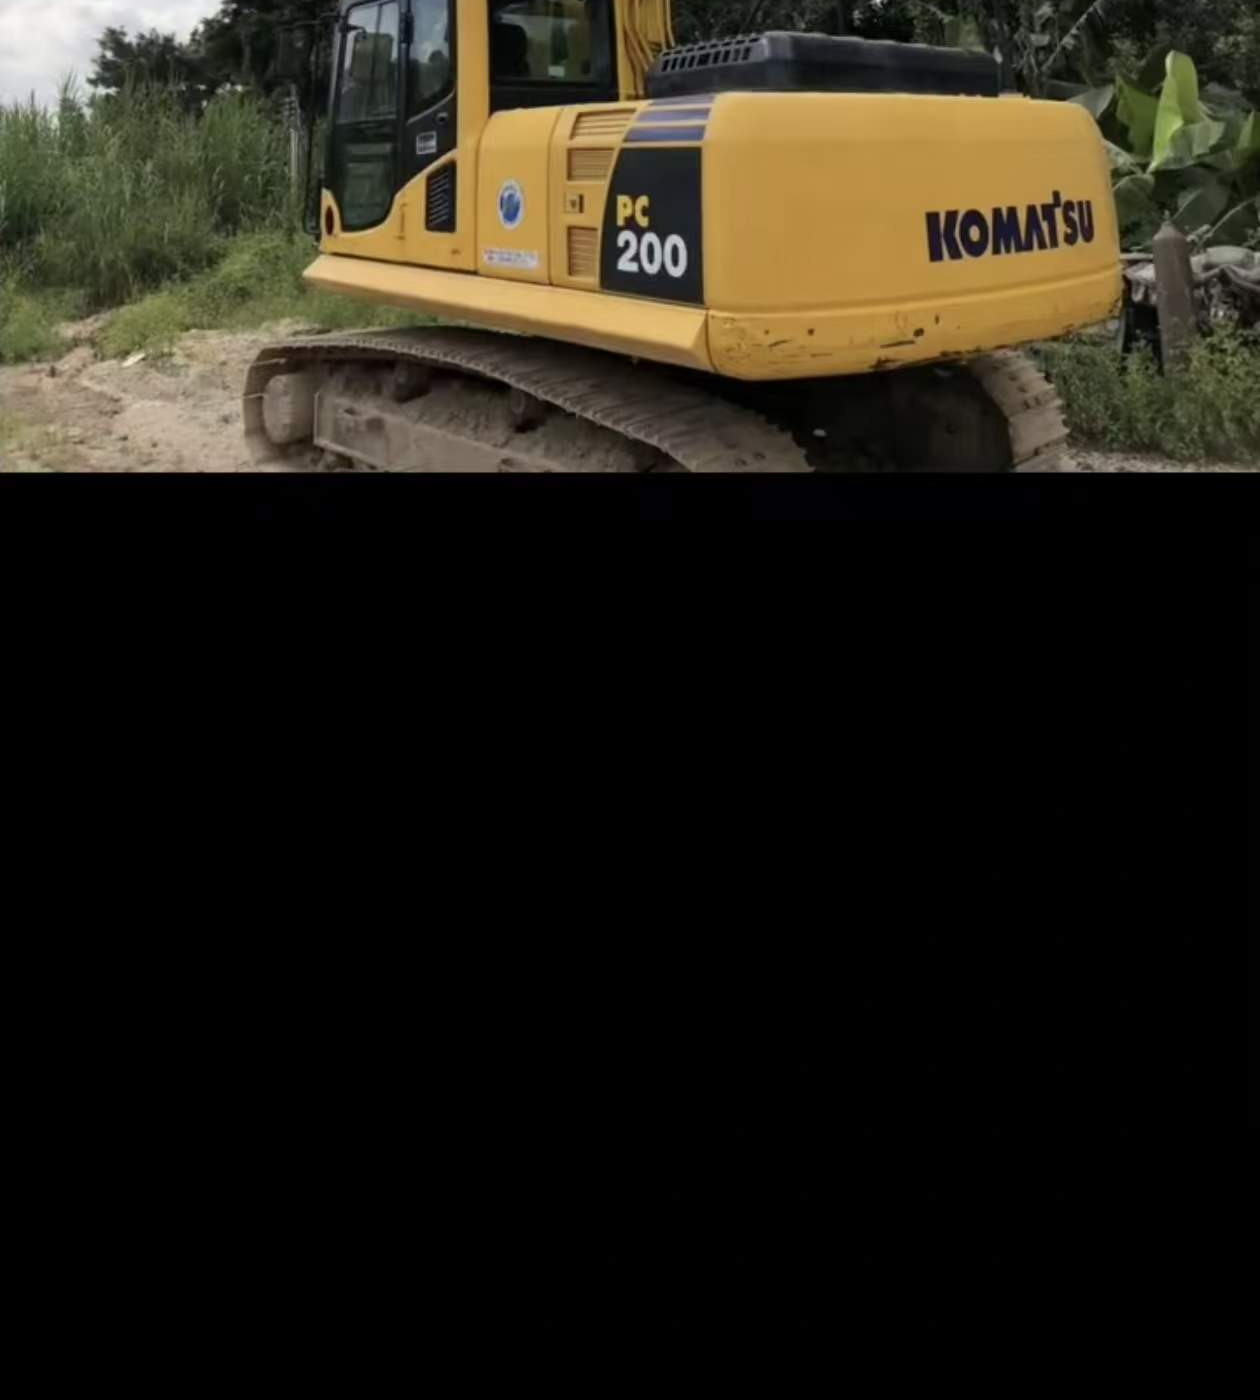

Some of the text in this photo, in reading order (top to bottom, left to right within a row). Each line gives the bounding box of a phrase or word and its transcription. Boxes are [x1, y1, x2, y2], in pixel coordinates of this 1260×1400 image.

[617, 195, 649, 227] PC
[925, 190, 1094, 262] KOMATSU
[617, 230, 687, 277] 200
